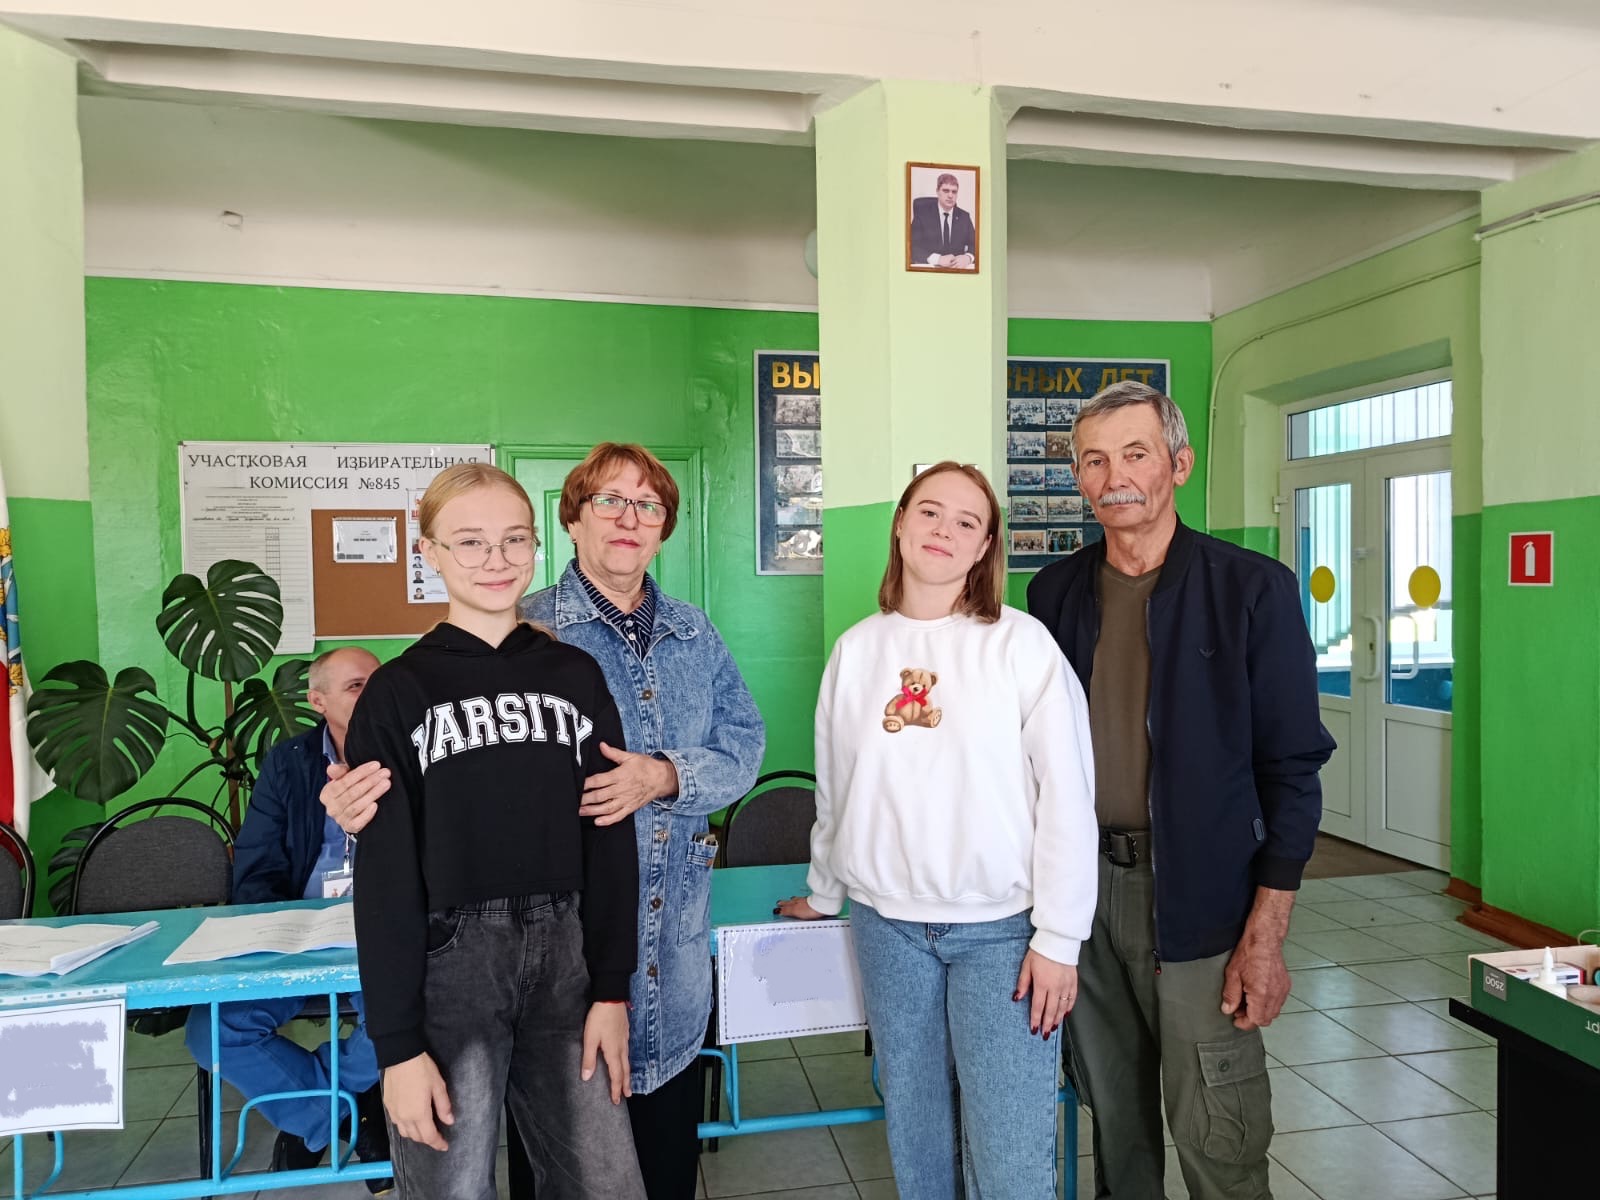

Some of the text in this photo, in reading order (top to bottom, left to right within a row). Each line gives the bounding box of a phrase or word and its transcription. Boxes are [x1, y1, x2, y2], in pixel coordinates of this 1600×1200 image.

[1007, 366, 1083, 393] НЫХ
[187, 454, 479, 470] УЧАСТКОВАЯ ИЗБИРАТЕЛЬНАЯ
[250, 476, 401, 490] КОМИССИЯ №845
[410, 692, 594, 777] VARSITY
[1485, 975, 1505, 992] 2500
